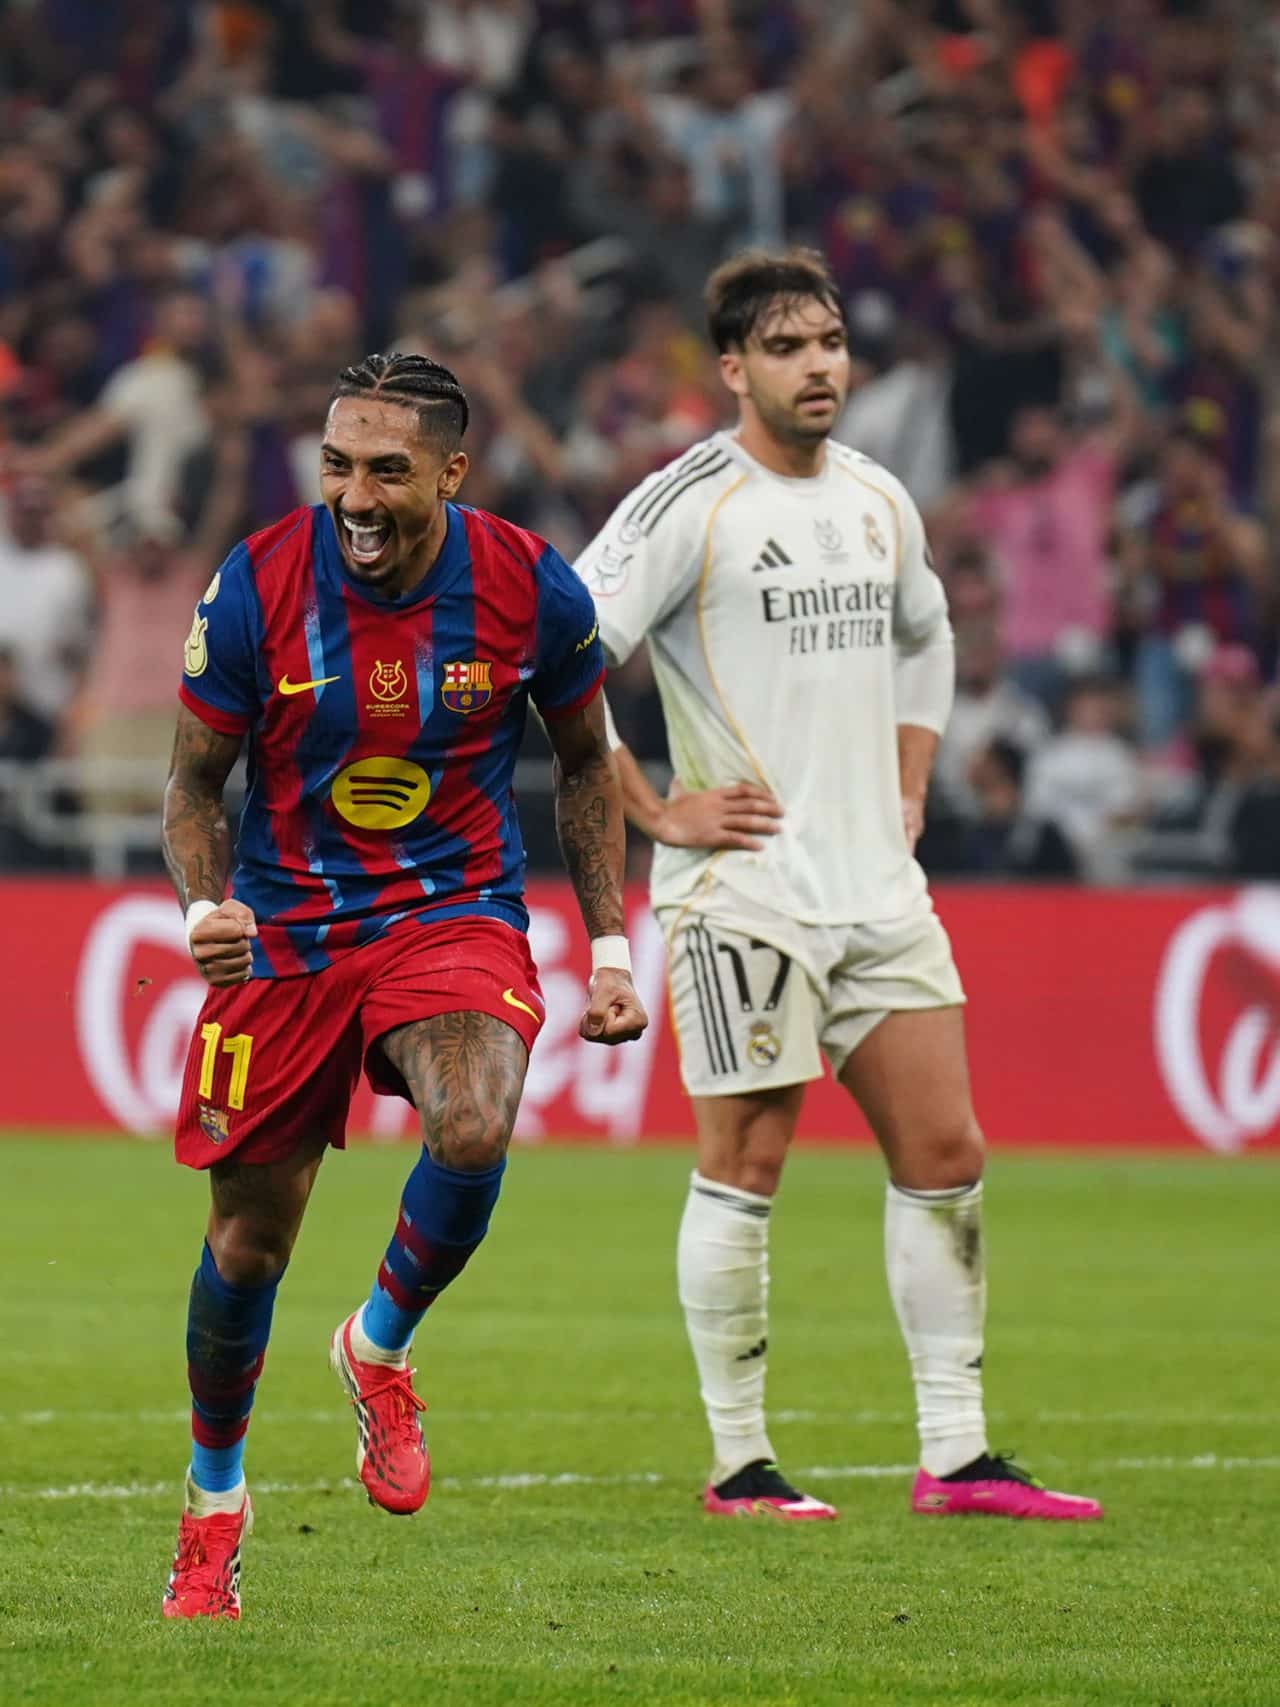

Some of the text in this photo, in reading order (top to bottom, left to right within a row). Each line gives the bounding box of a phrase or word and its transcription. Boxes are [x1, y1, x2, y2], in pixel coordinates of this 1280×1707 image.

[790, 618, 885, 656] FLY BETTER
[718, 937, 792, 1012] 17
[198, 1021, 255, 1112] 11
